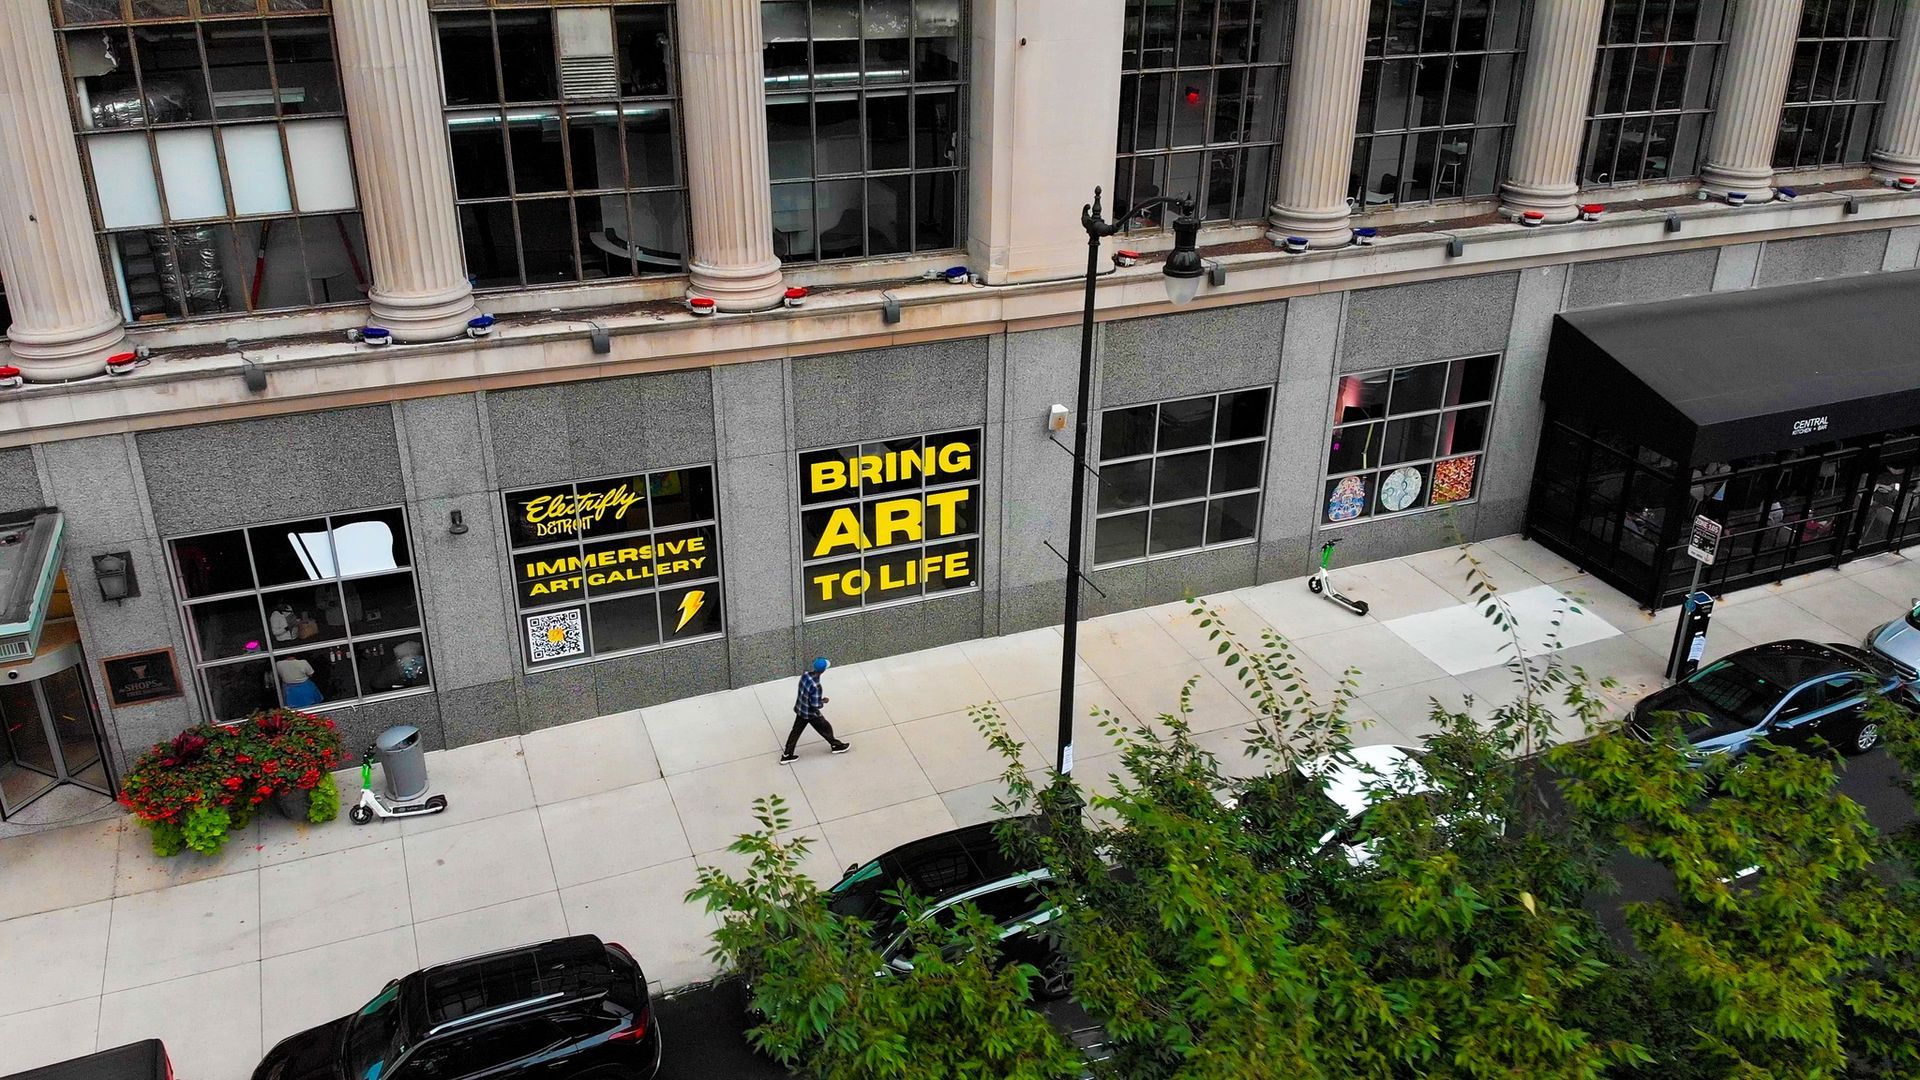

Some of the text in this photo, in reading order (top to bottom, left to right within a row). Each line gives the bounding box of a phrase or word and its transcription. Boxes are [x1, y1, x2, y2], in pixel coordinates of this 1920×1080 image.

[1793, 416, 1829, 430] CENTRAL
[810, 442, 971, 494] BRING
[525, 483, 645, 523] Electrifly
[813, 489, 969, 557] ART
[536, 515, 594, 537] DETROIT
[526, 536, 706, 578] IMMERSIVE
[529, 556, 707, 597] ART GALLERY
[813, 551, 969, 601] TO LIFE
[125, 680, 158, 692] SHOPS
